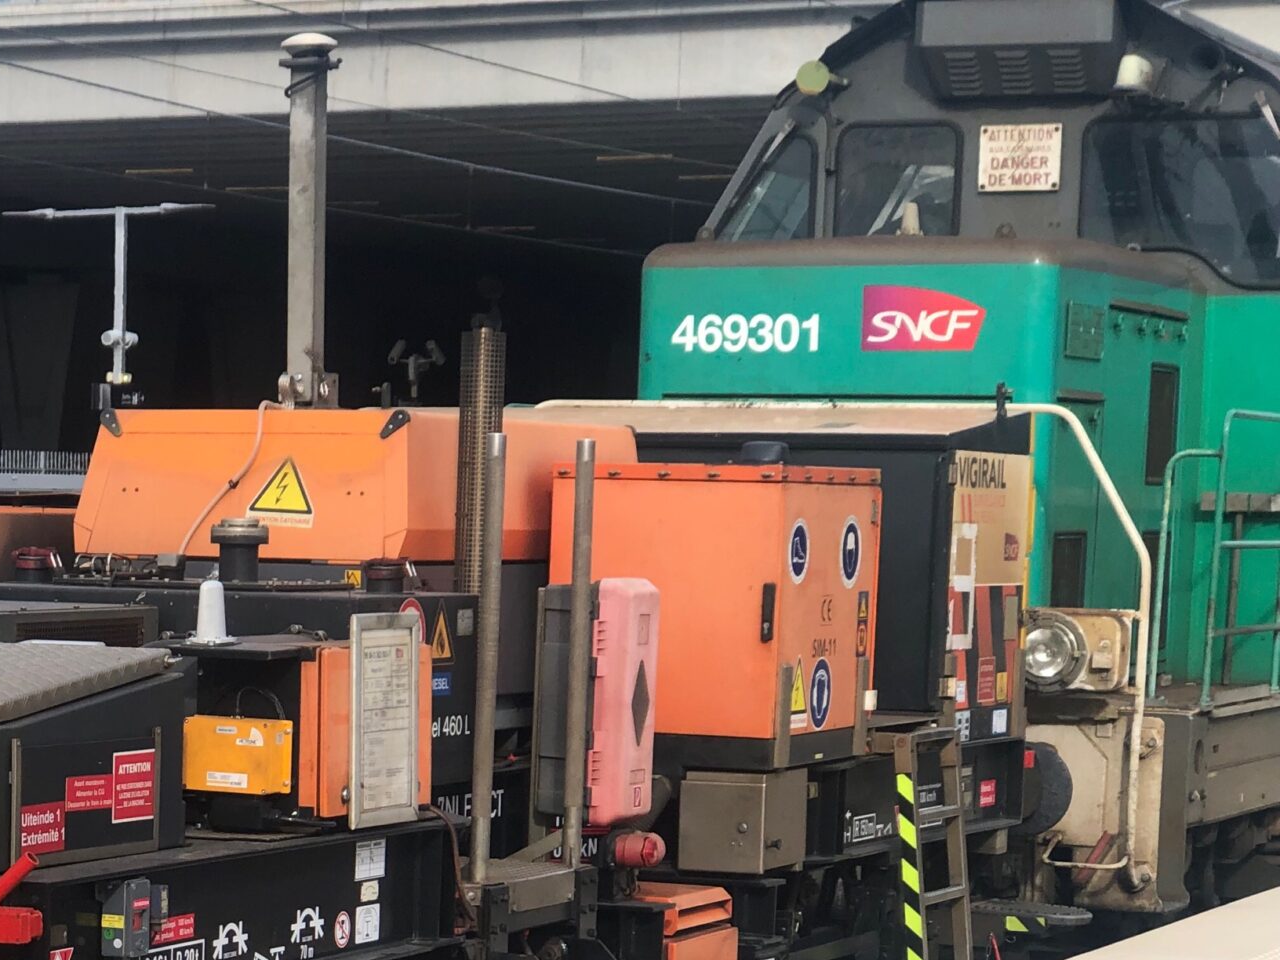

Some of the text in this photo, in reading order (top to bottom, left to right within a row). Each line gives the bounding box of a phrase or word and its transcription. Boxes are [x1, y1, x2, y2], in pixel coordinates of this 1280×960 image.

[989, 127, 1053, 141] ATTENTION
[991, 156, 1049, 170] DANGER
[988, 172, 1051, 187] DE MORT
[671, 313, 820, 353] 469301
[866, 309, 979, 342] SNCF
[959, 457, 1006, 489] VIGIRAIL
[432, 678, 449, 690] IESEL
[442, 715, 463, 737] 460
[464, 714, 471, 735] L
[118, 762, 151, 775] ATTENTION
[21, 808, 61, 827] Uiteinde 1
[21, 827, 65, 846] Extrémité 1
